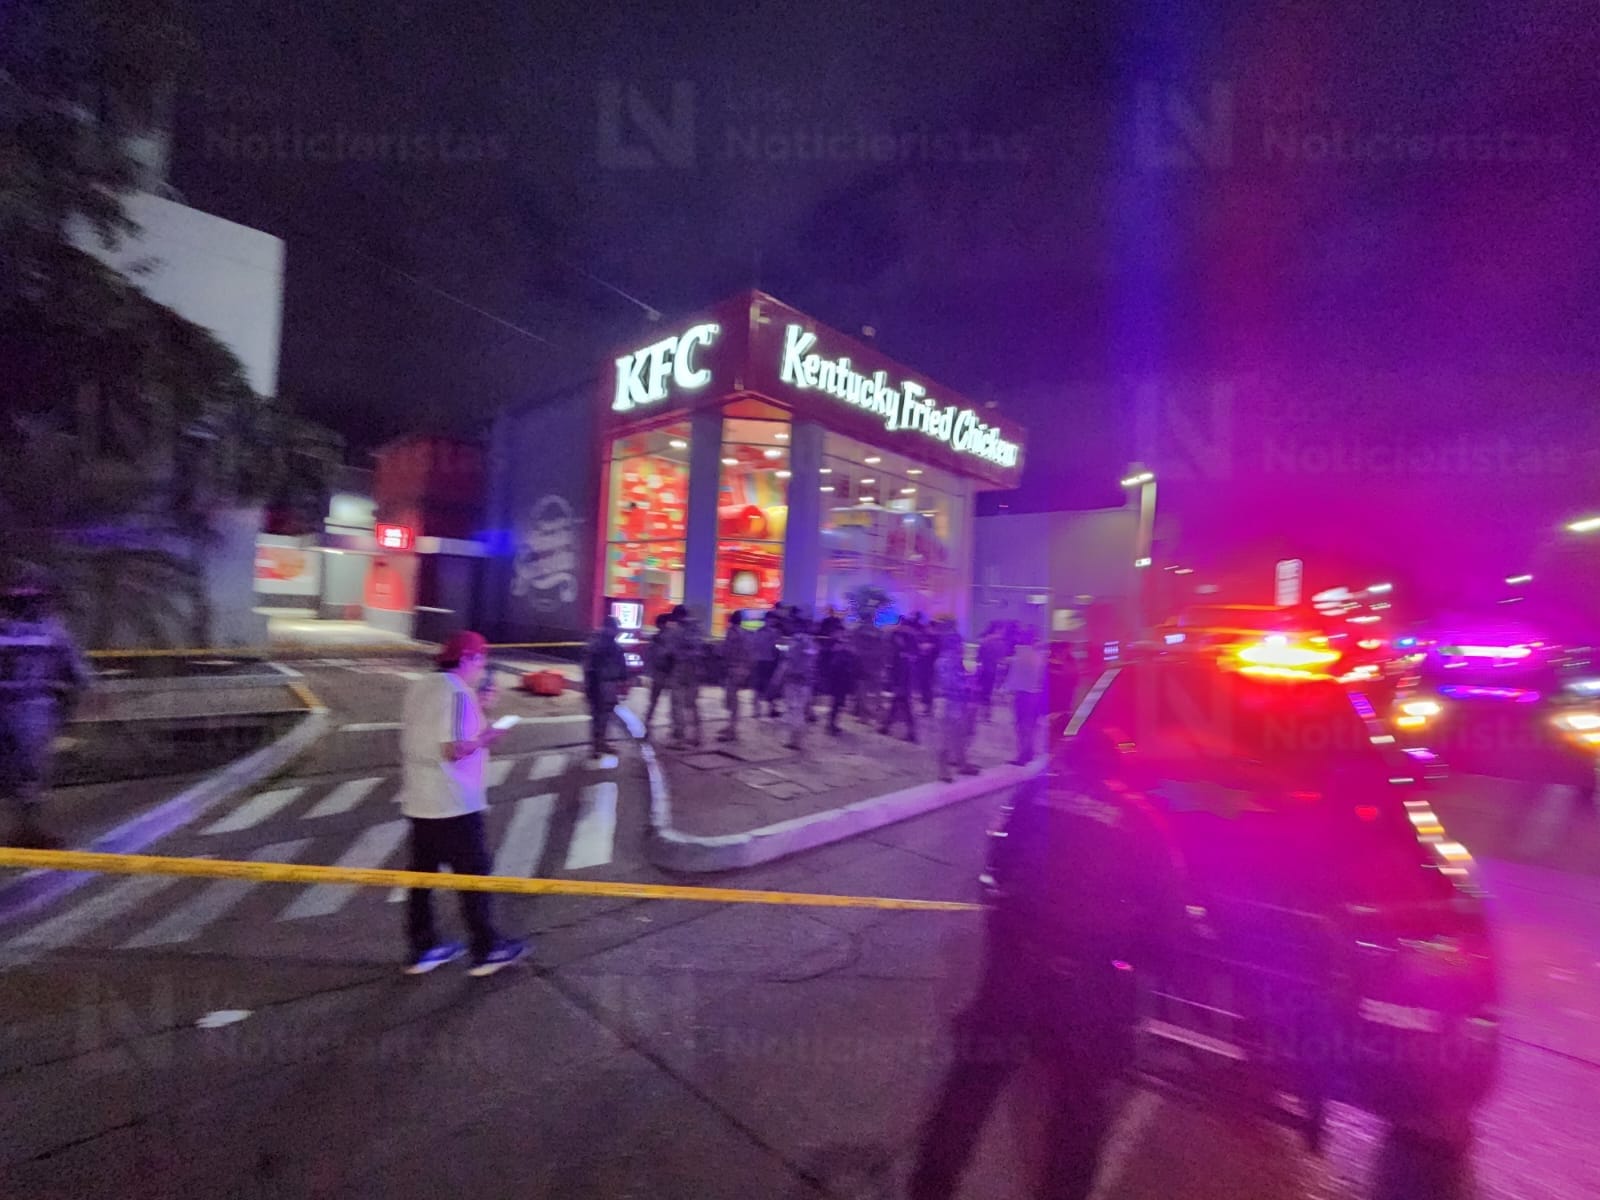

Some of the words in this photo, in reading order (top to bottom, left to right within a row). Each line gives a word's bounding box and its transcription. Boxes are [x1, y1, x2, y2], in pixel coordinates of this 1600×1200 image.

[612, 323, 718, 410] KFC
[781, 324, 904, 430] Kentucky
[900, 381, 955, 441] Fried
[952, 410, 1019, 468] Chicken
